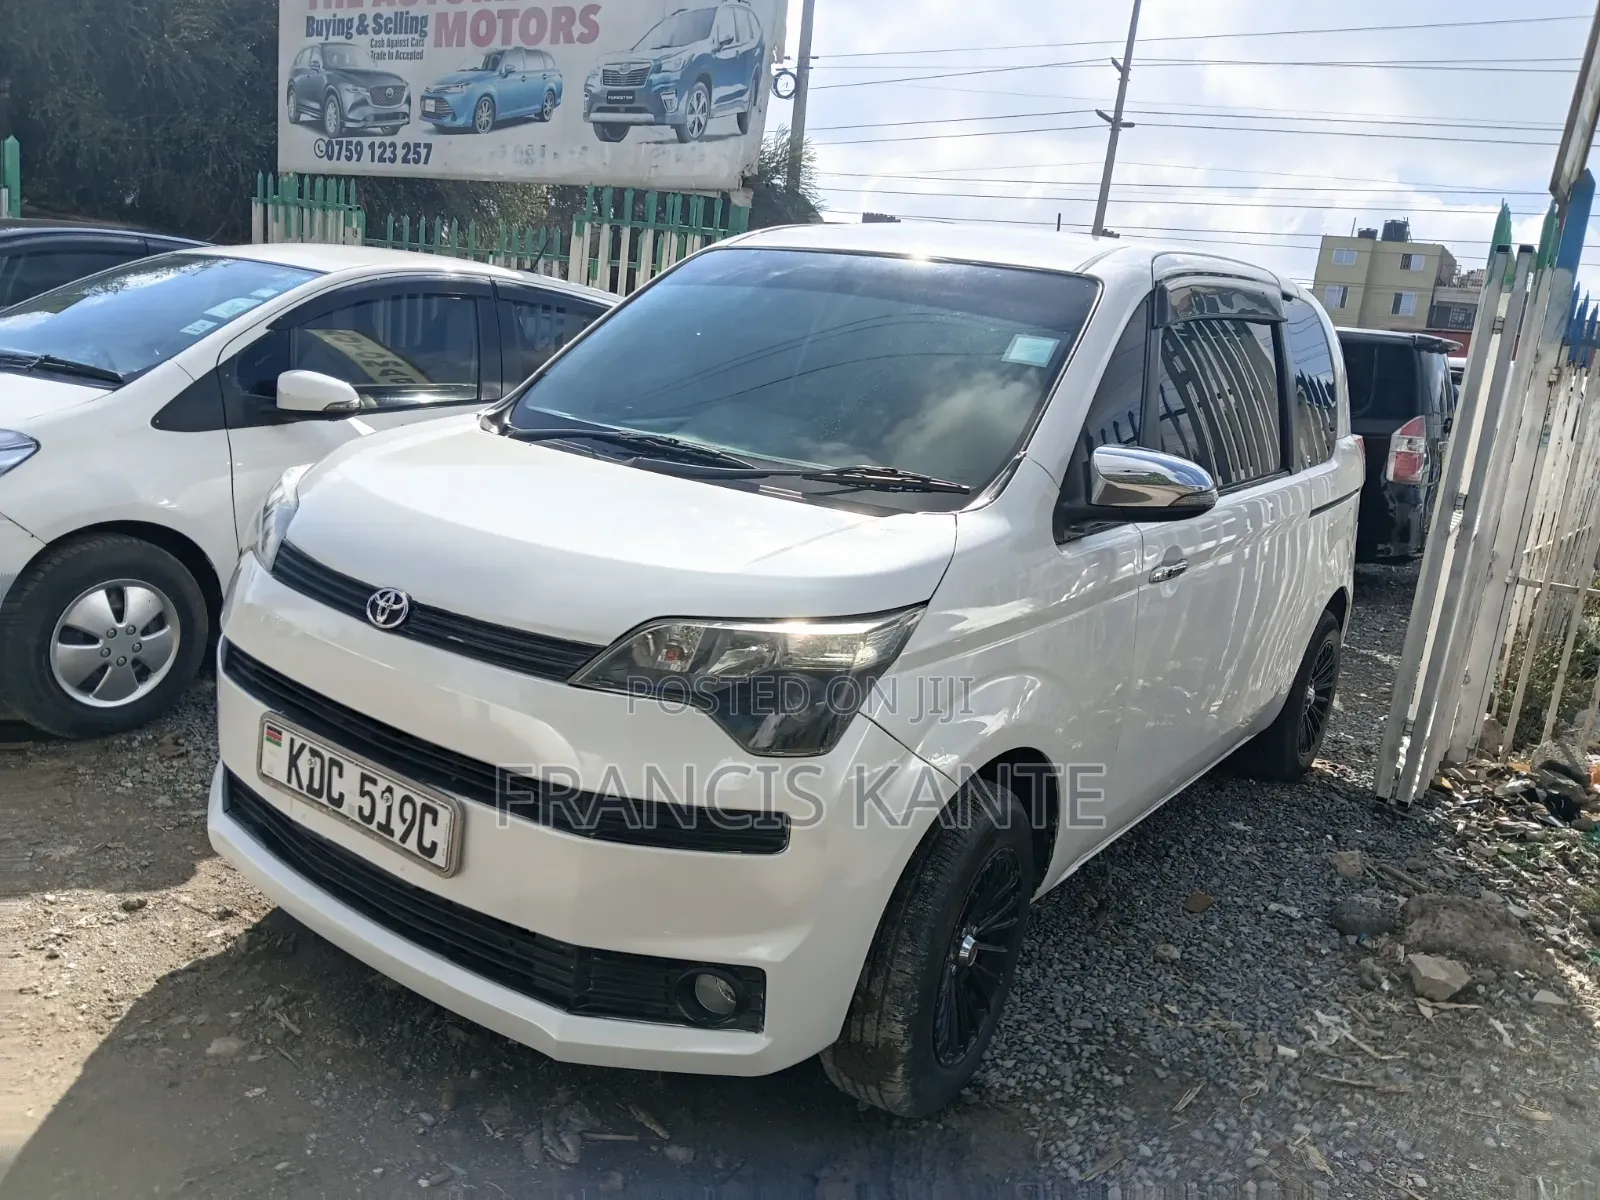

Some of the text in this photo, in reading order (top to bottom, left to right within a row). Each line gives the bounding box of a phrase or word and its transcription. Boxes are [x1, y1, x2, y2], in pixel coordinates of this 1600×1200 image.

[305, 10, 429, 41] Buying & Selling
[433, 4, 602, 48] MOTORS
[370, 37, 425, 49] Cash Against Cars
[370, 50, 424, 61] Trade In Accepted
[325, 139, 433, 165] 0759 123 257
[287, 736, 345, 809] KDC
[357, 771, 439, 859] 519C
